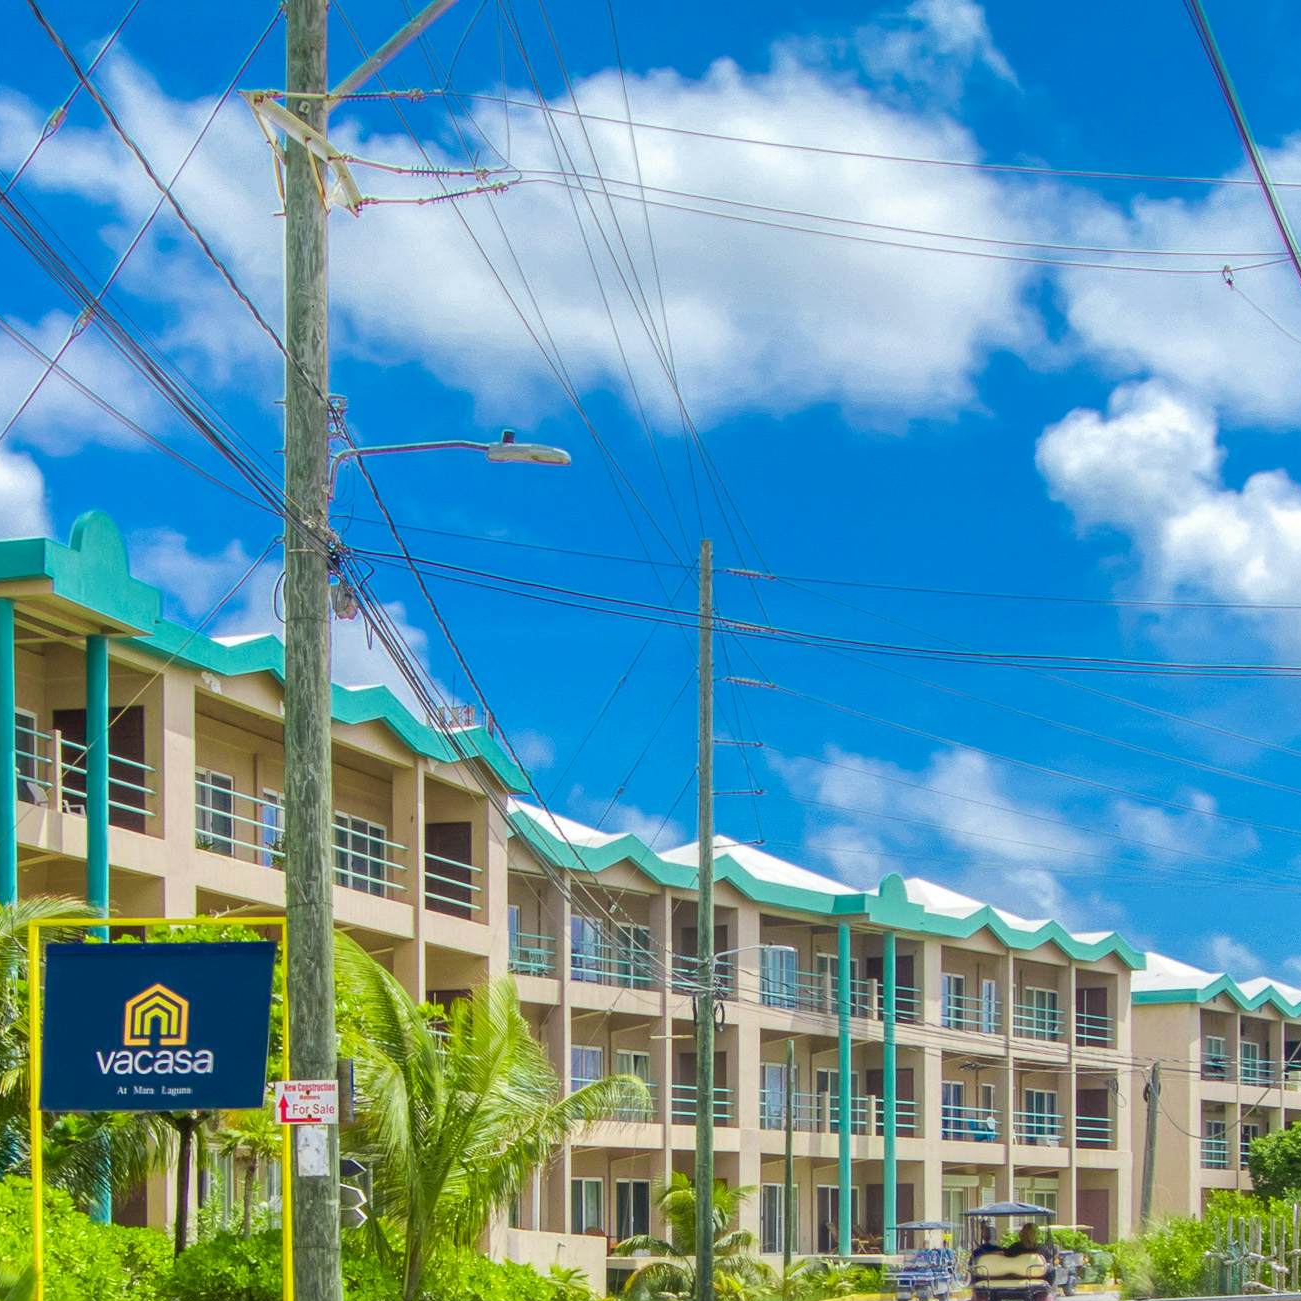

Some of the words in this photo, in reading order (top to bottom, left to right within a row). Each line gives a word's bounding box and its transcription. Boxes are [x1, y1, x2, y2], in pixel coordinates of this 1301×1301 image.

[96, 1049, 215, 1075] vacasa
[117, 1086, 128, 1095] At
[133, 1086, 155, 1095] Mara
[161, 1085, 193, 1097] Laguna
[298, 1082, 335, 1092] Construction
[292, 1104, 309, 1115] For
[313, 1103, 335, 1115] Sale
